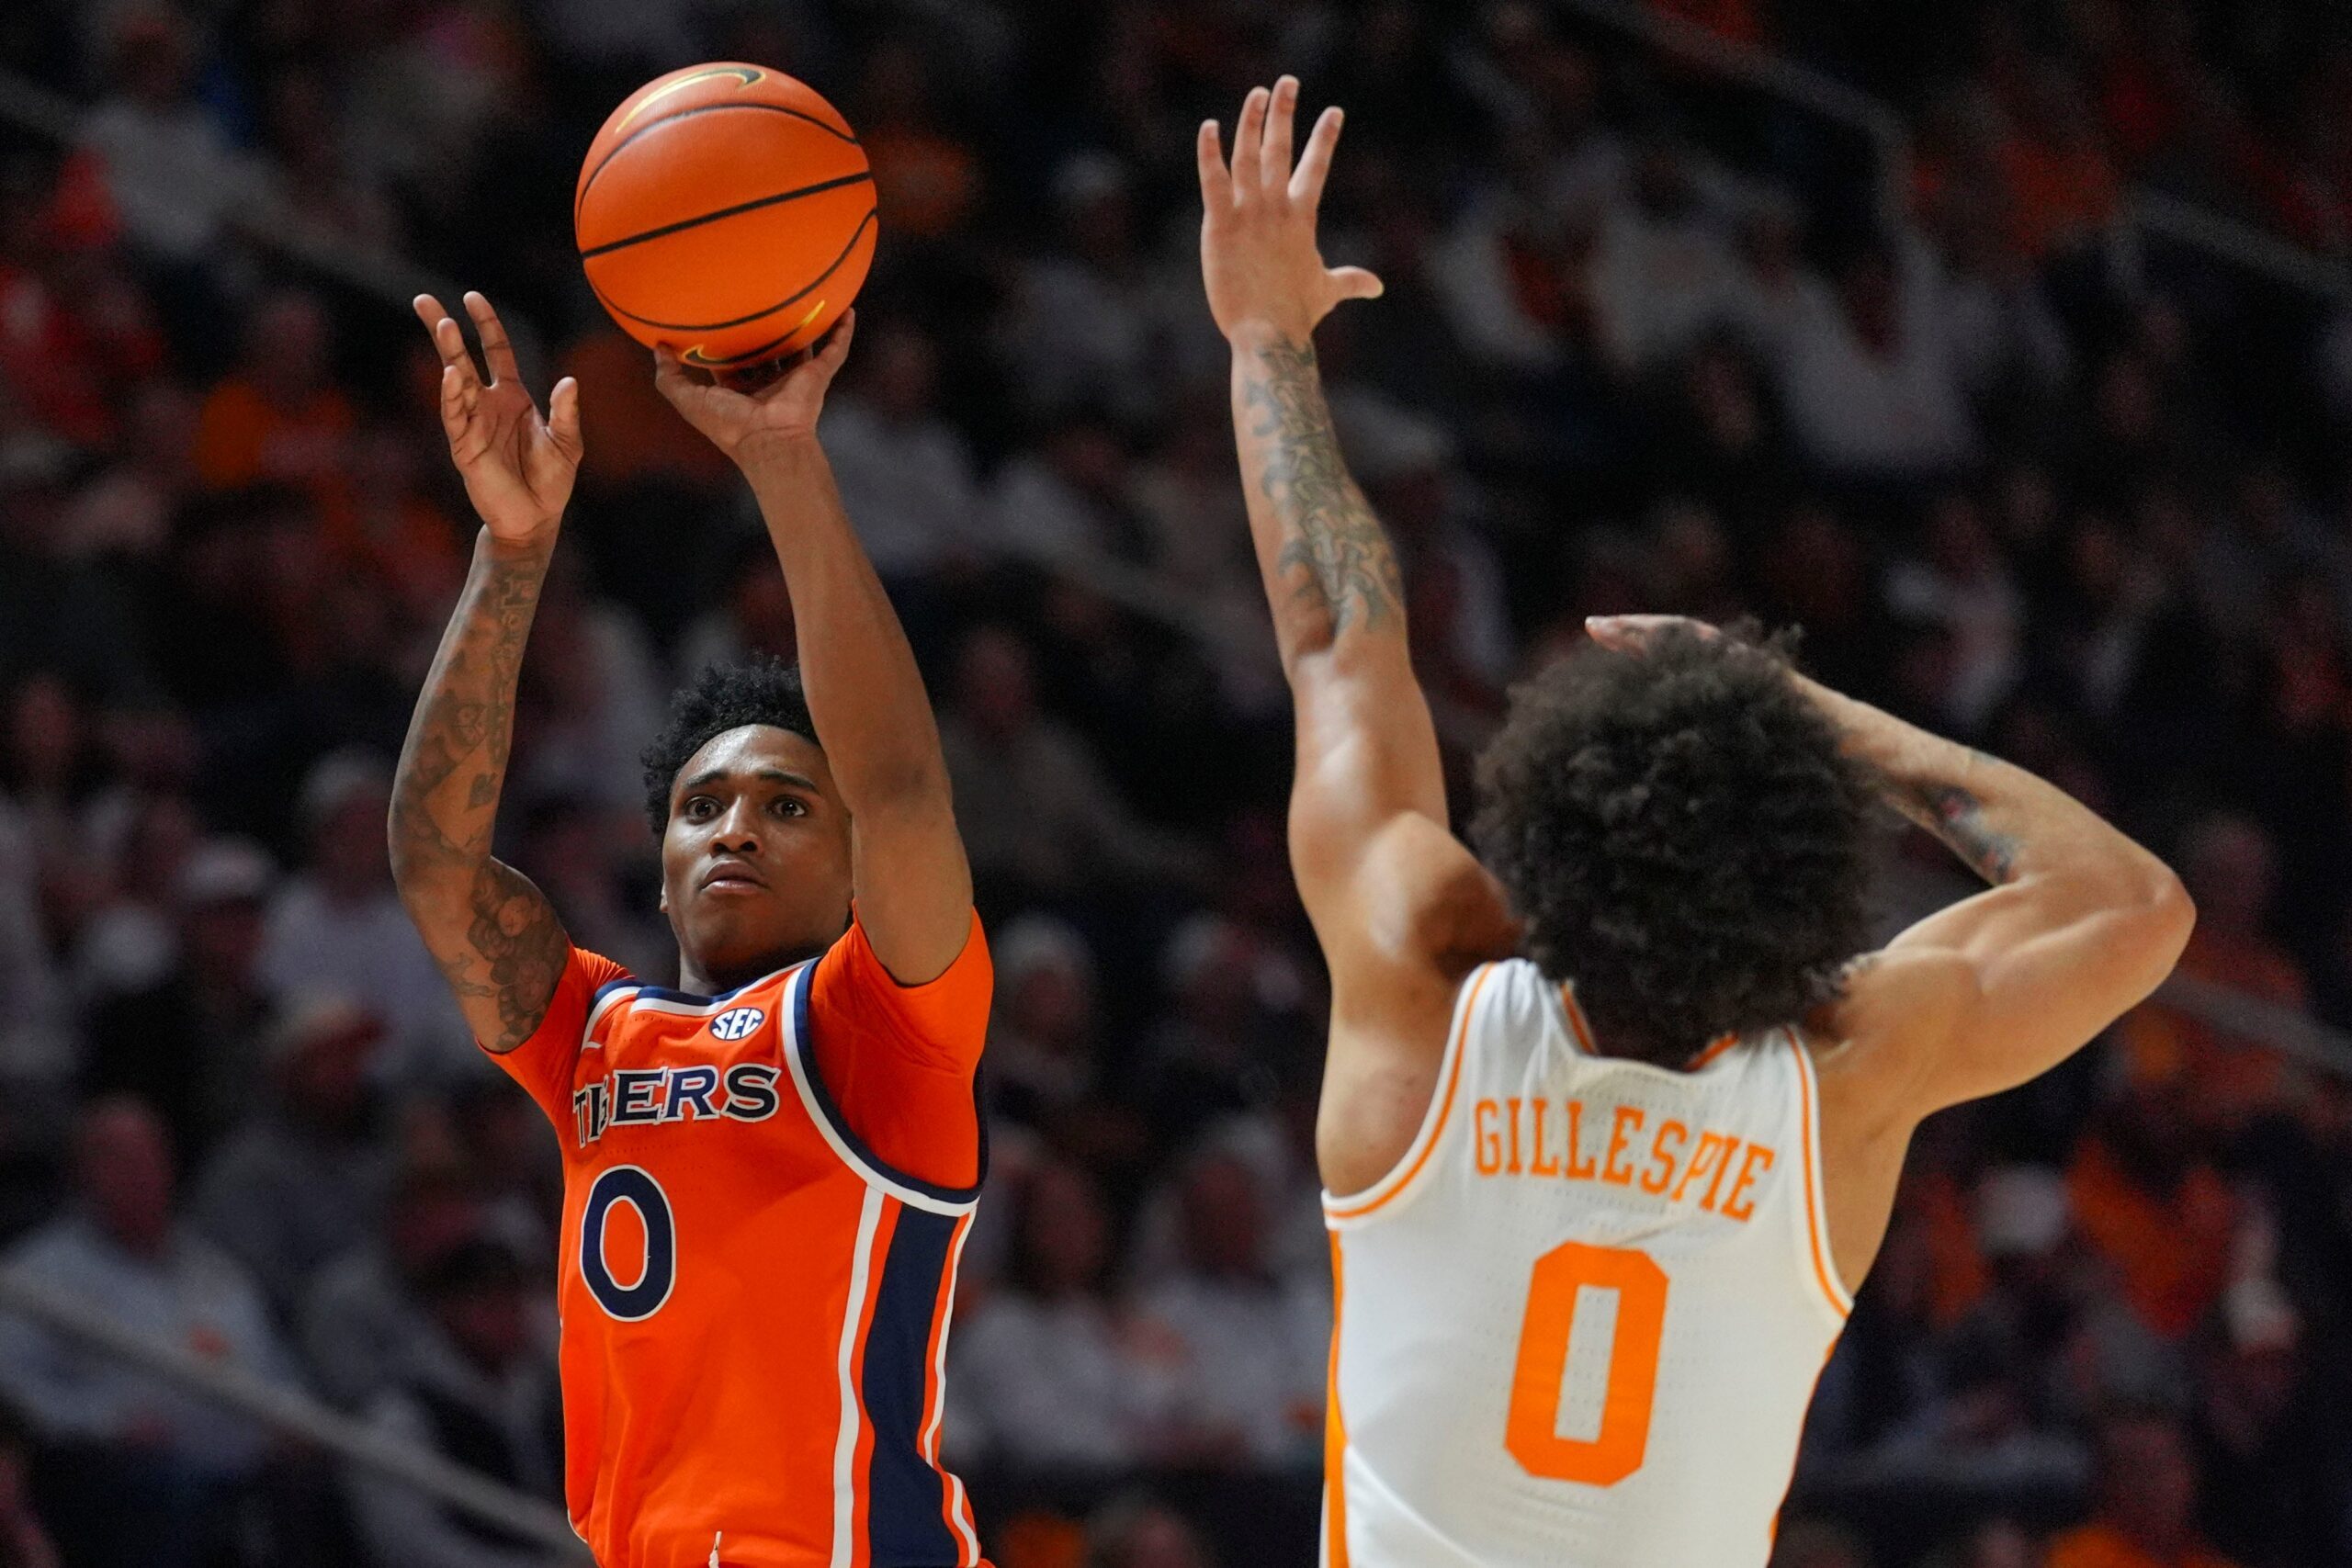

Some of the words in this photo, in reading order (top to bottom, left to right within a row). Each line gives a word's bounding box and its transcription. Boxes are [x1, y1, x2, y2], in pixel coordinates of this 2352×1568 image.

[711, 1009, 763, 1040] SEC
[1475, 1098, 1775, 1223] GILLESPIE
[580, 1164, 676, 1323] 0
[1504, 1240, 1670, 1487] 0
